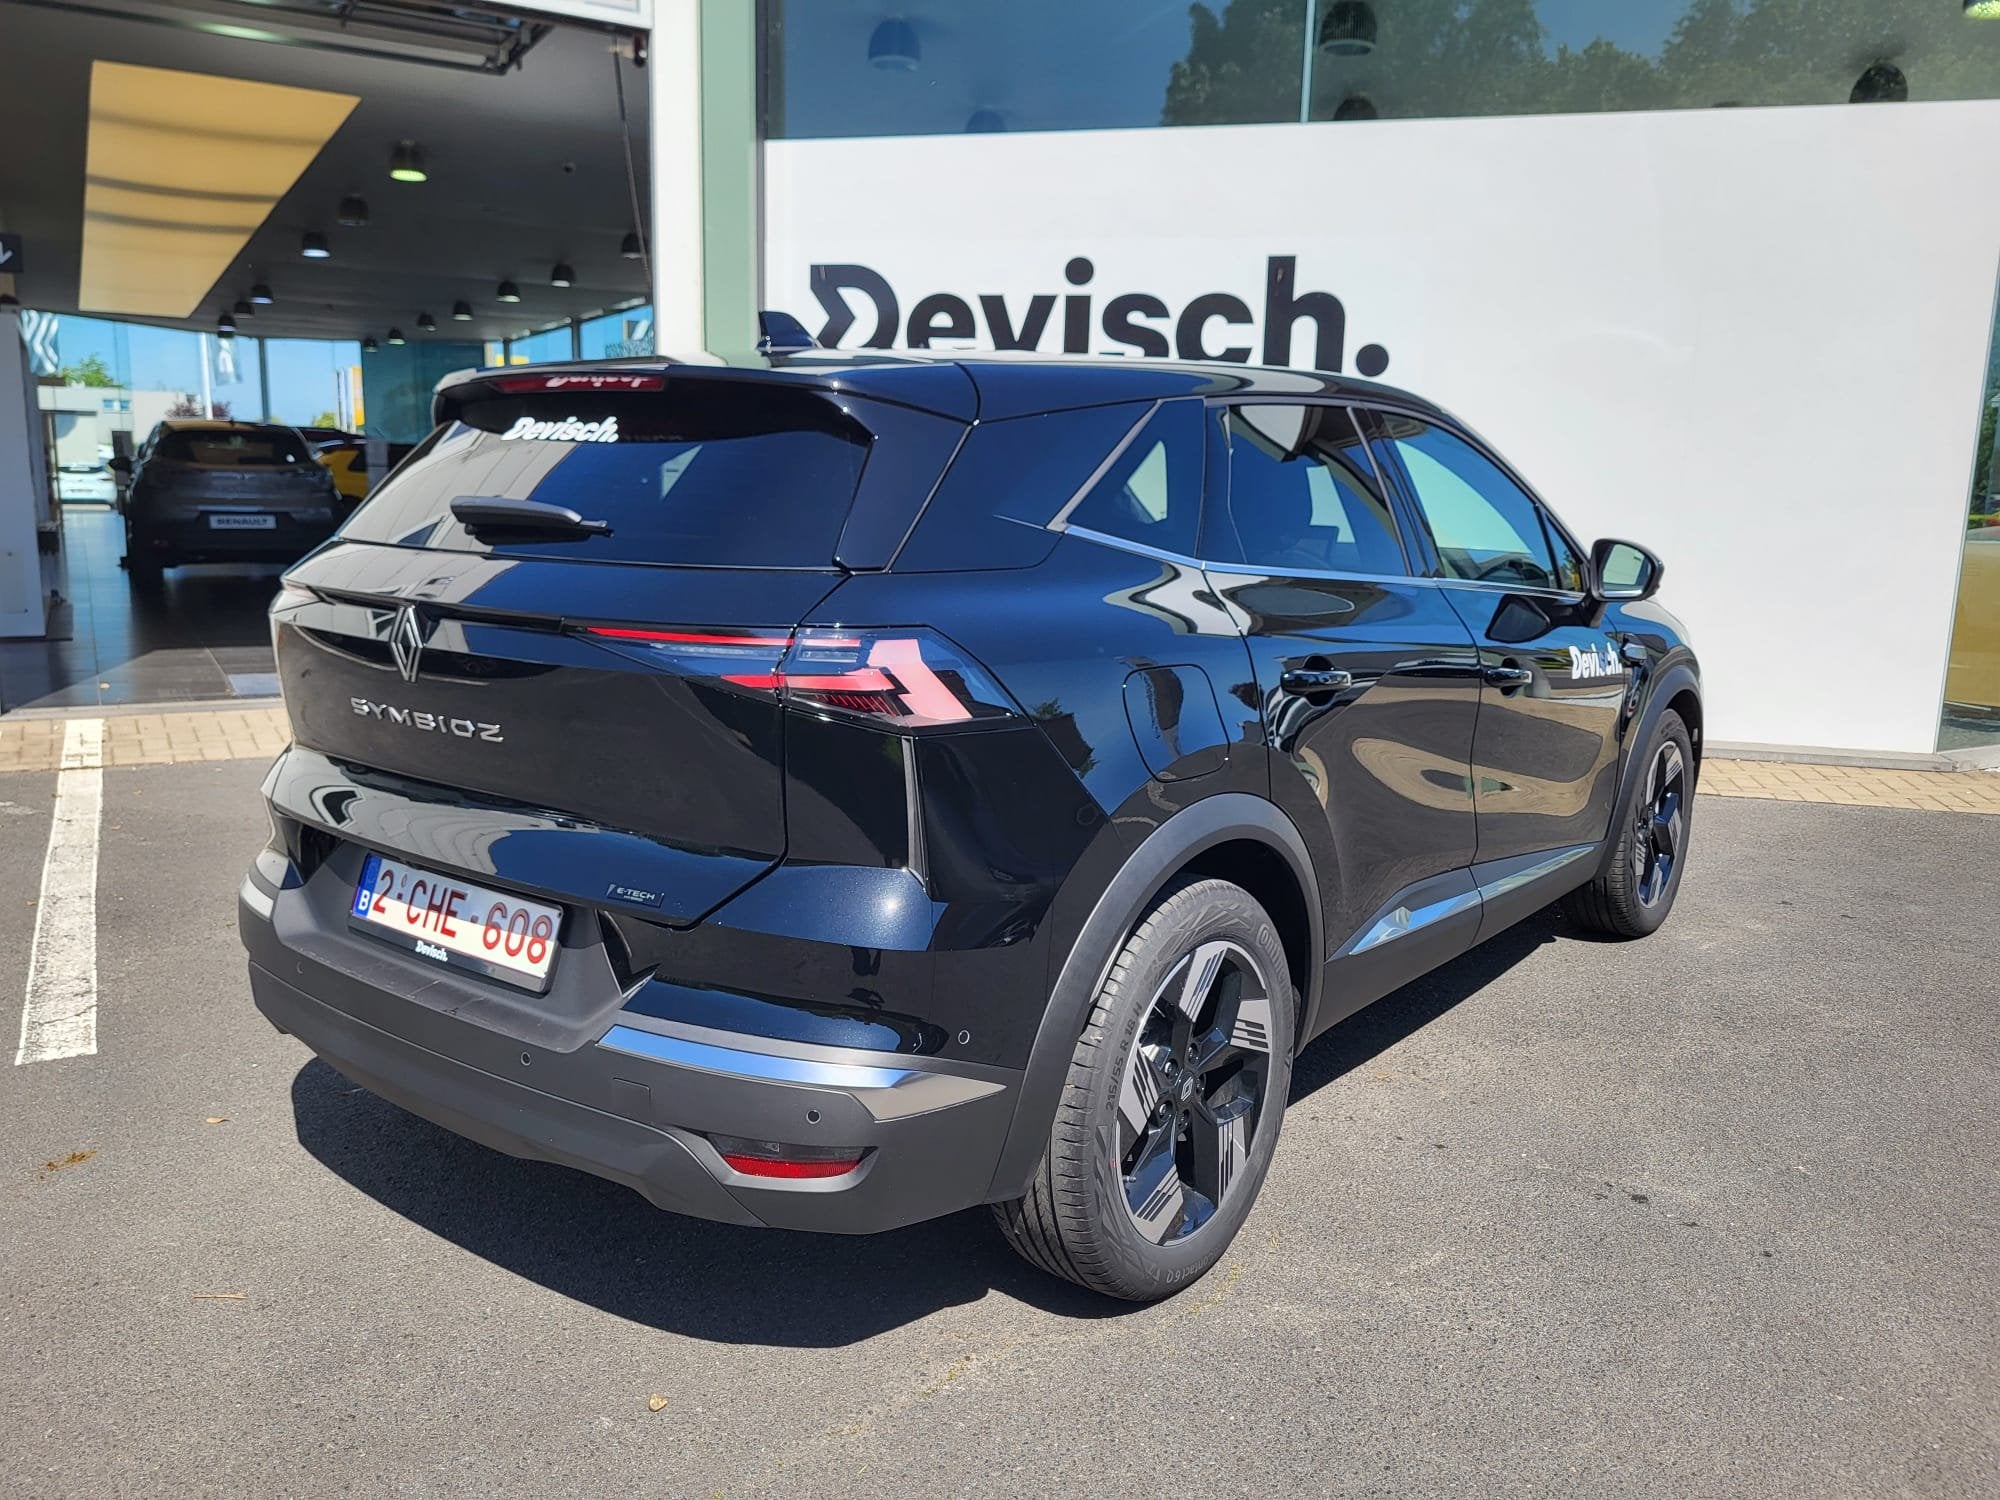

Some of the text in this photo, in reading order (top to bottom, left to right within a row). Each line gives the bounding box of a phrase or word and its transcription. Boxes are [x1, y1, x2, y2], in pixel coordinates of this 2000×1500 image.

[810, 255, 1390, 377] Devisch.
[501, 416, 619, 443] Devisch.
[350, 697, 504, 743] SYMBIOZ
[358, 890, 371, 911] B
[616, 887, 656, 900] E-TECH
[414, 940, 449, 963] Devisch.
[1105, 1055, 1124, 1112] 215/55
[1120, 1039, 1129, 1052] R
[1125, 1020, 1136, 1036] 18
